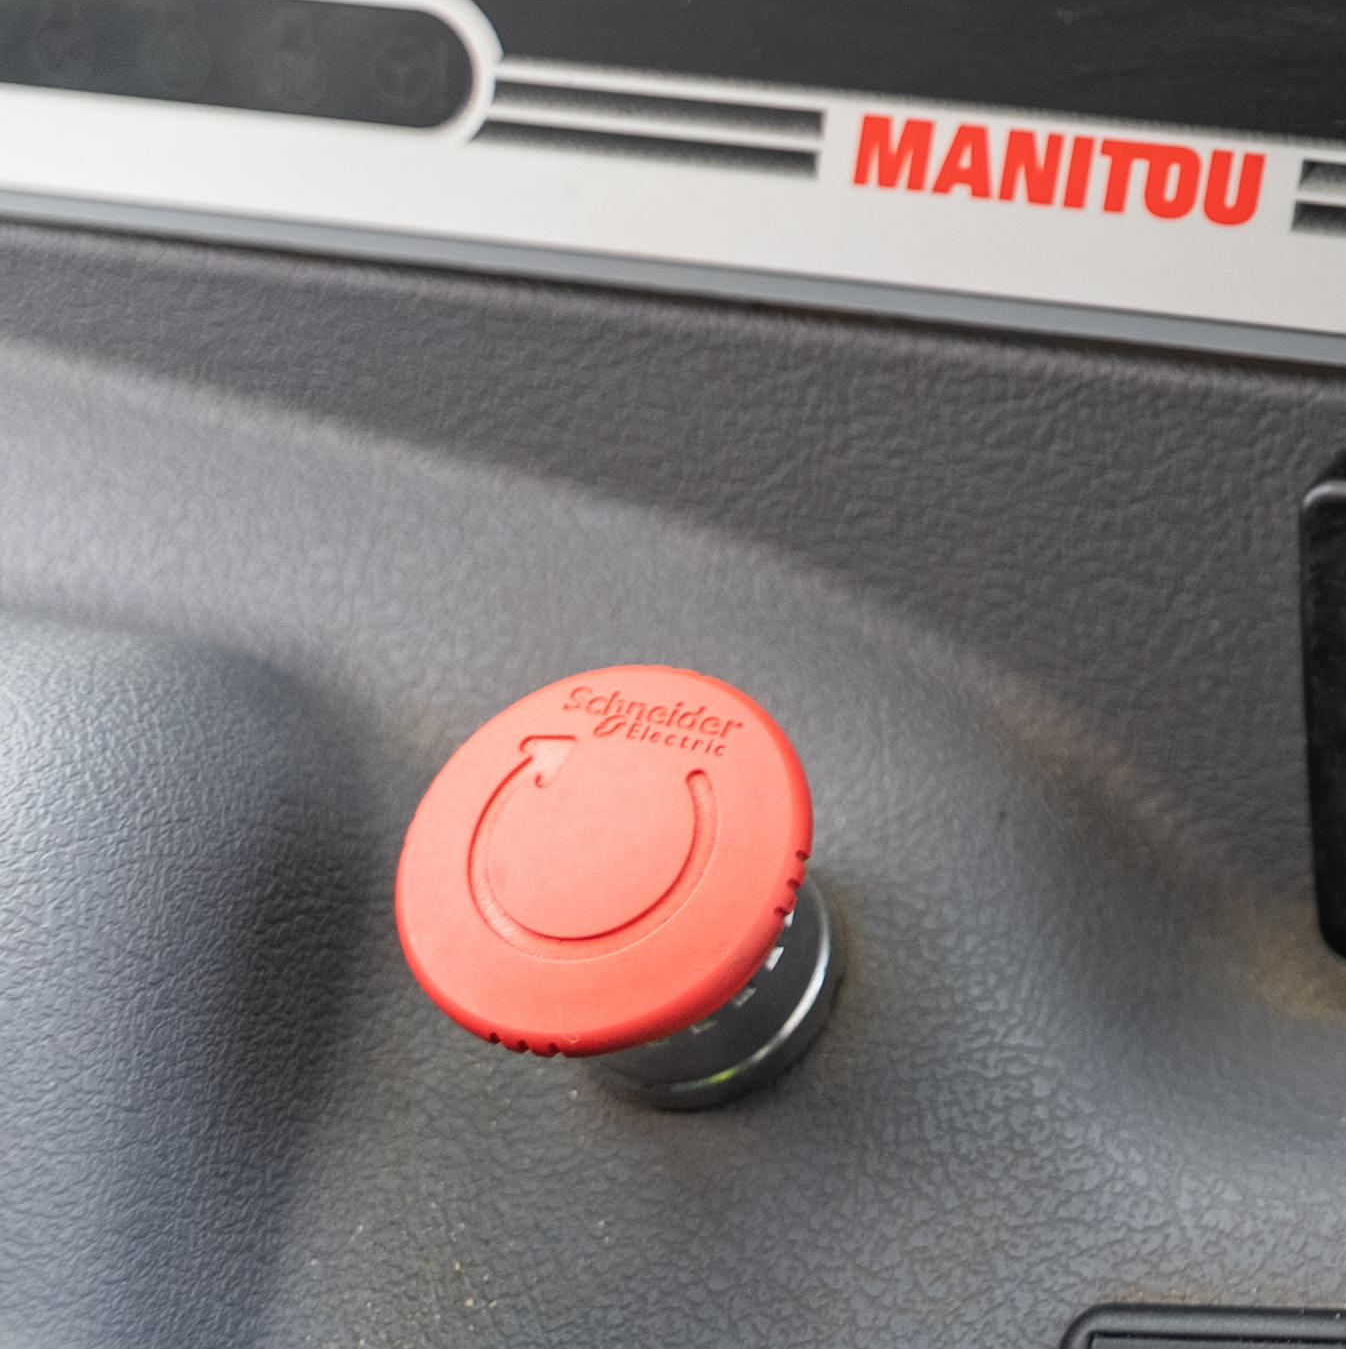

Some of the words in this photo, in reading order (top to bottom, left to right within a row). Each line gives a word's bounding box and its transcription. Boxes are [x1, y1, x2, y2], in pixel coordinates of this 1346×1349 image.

[852, 113, 1266, 226] MANITOU
[562, 685, 745, 739] Schneider
[624, 722, 727, 758] Electric
